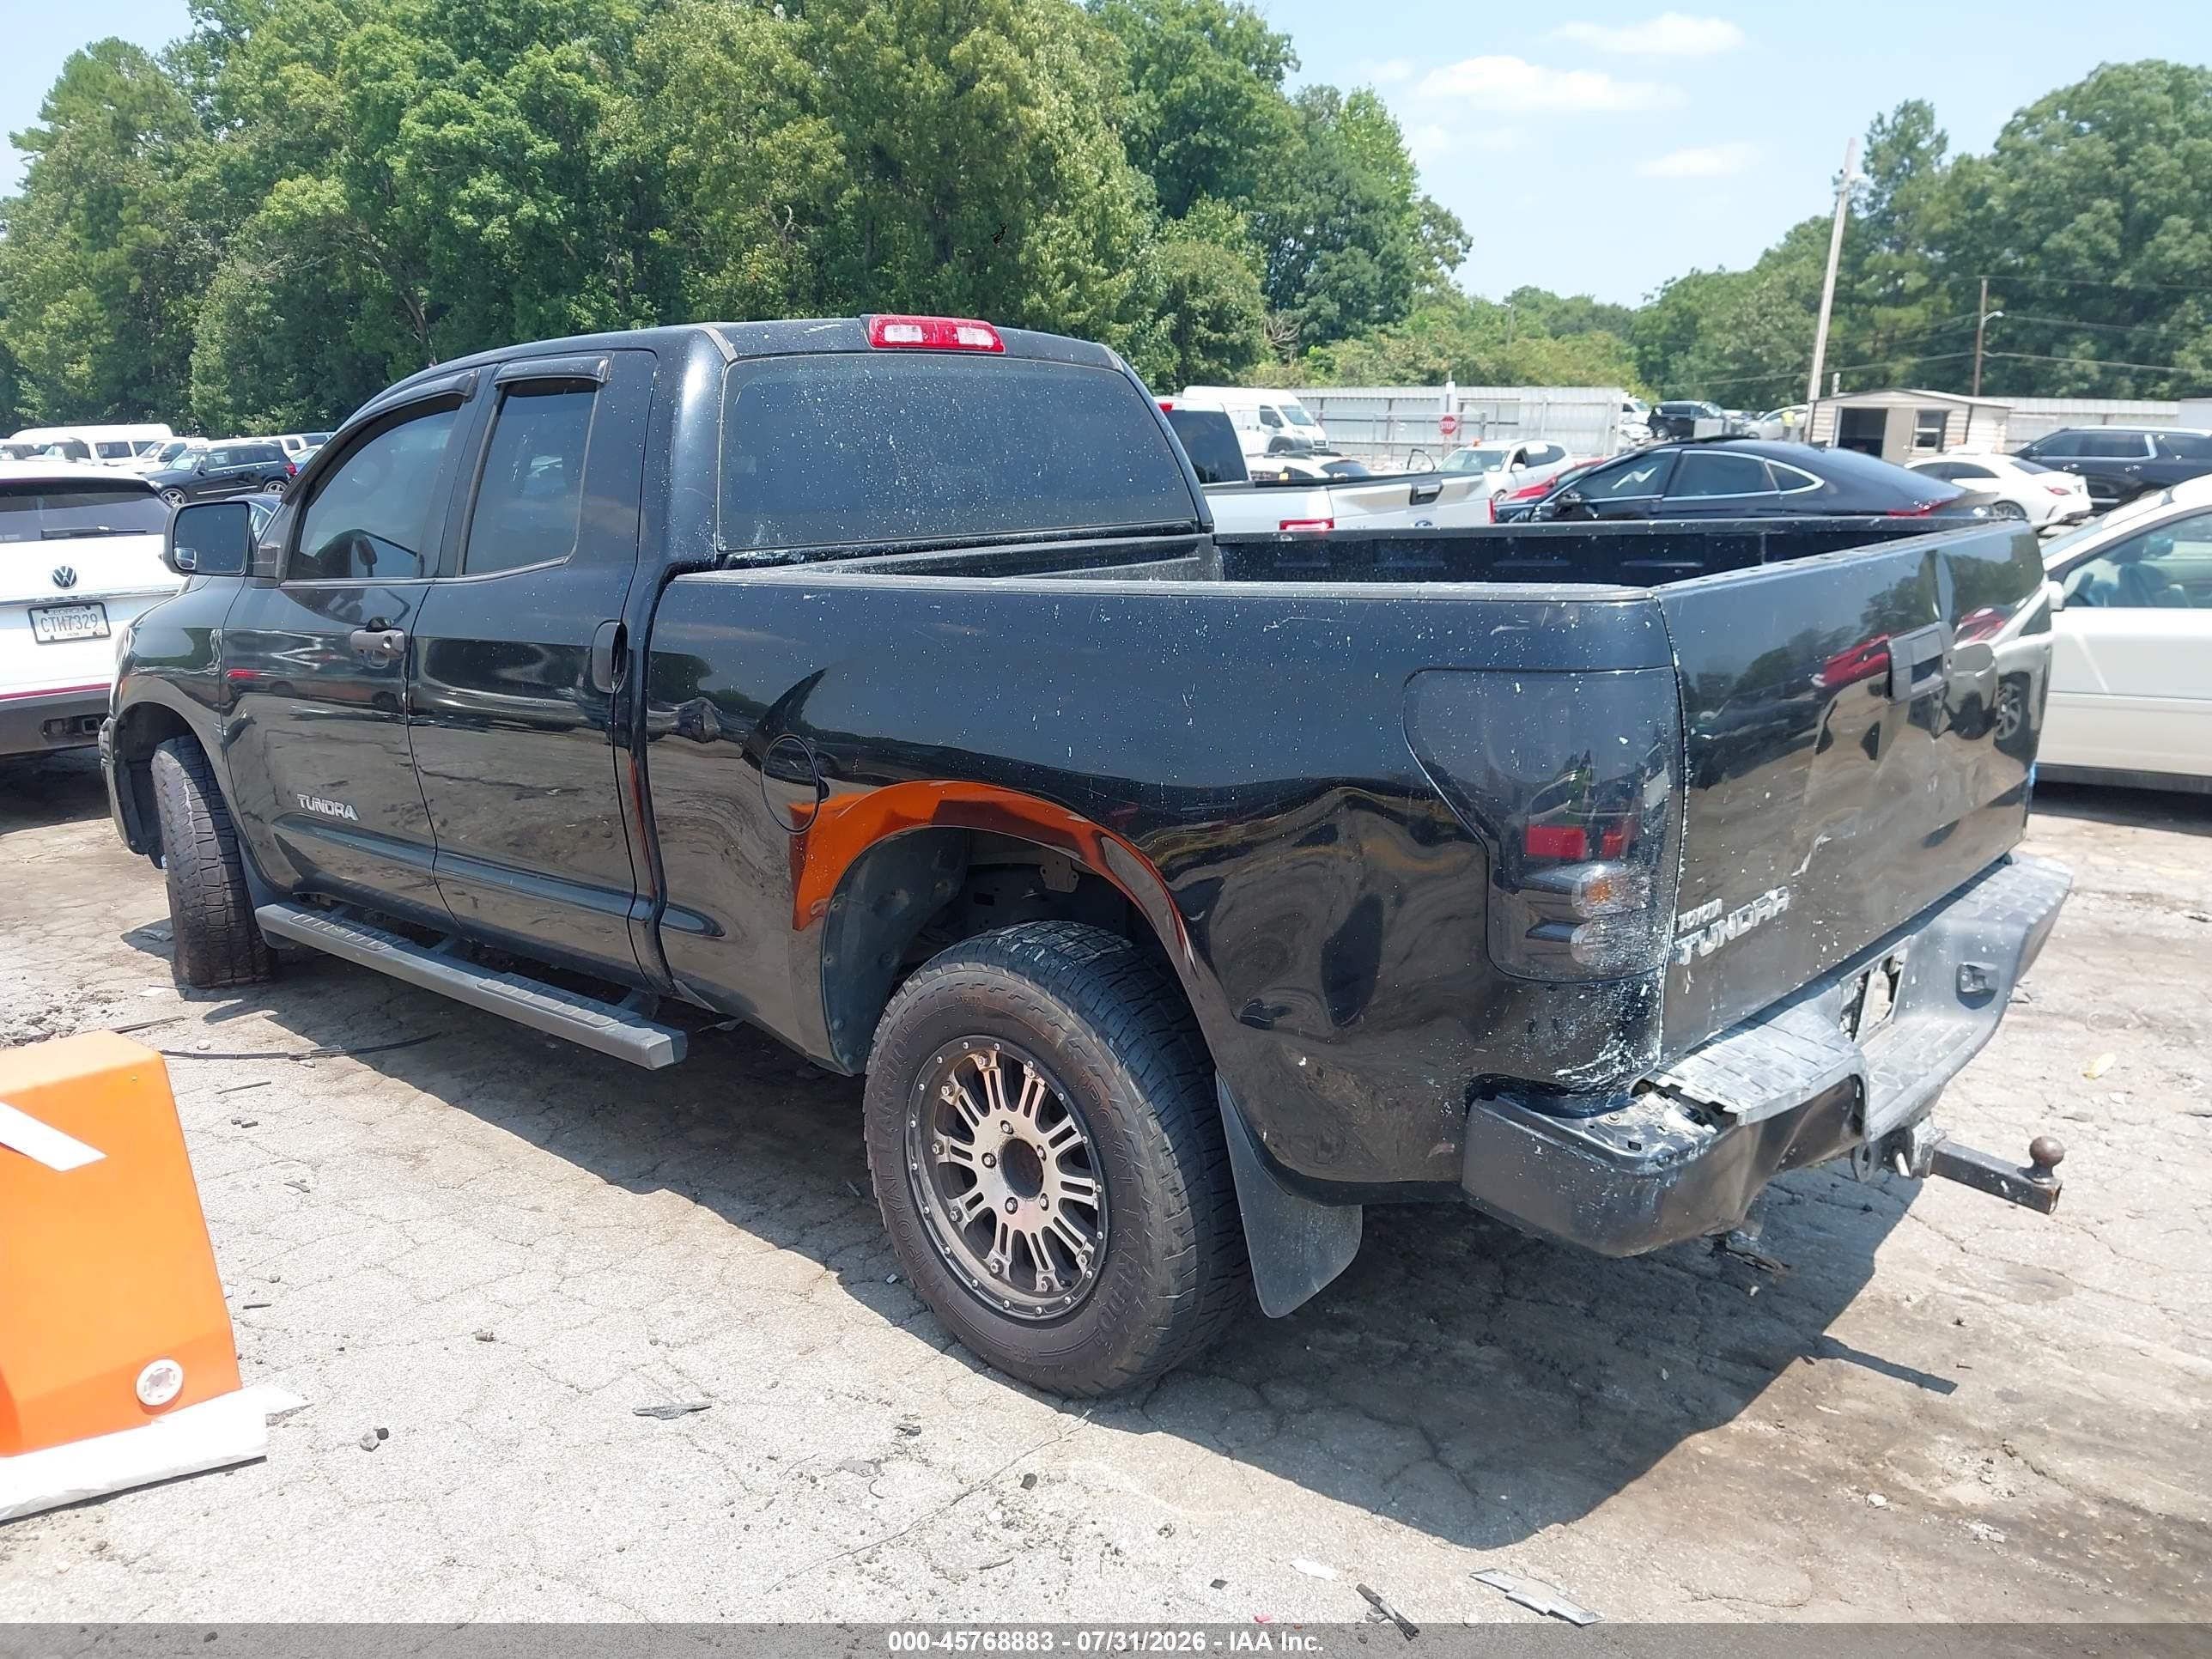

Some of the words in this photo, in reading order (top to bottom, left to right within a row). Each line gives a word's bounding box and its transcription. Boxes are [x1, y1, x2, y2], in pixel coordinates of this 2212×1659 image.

[296, 793, 359, 821] TUNDRA
[1673, 885, 1790, 966] TUNDRA
[1677, 897, 1723, 933] TOYOTA
